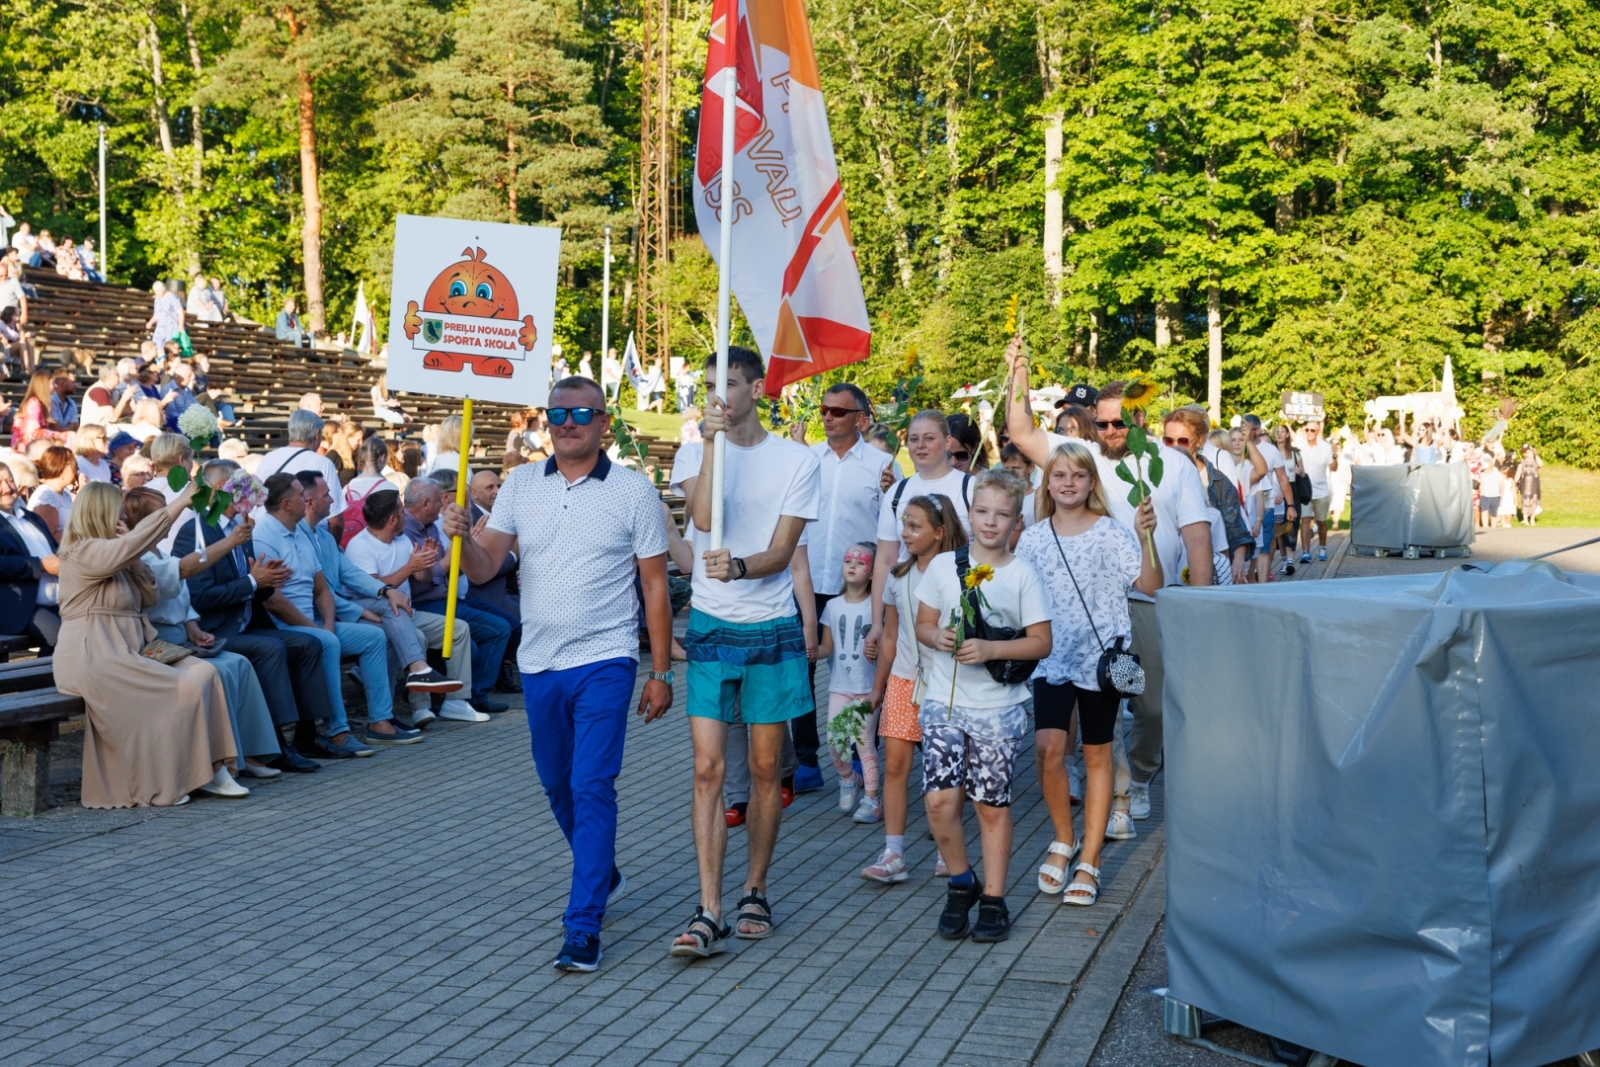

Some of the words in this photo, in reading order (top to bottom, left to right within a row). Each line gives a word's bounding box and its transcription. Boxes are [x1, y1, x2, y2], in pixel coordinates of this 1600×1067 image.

[444, 322, 475, 335] PREIĻU
[478, 325, 517, 337] NOVADA
[443, 335, 481, 347] SPORTA
[484, 339, 517, 350] SKOLA
